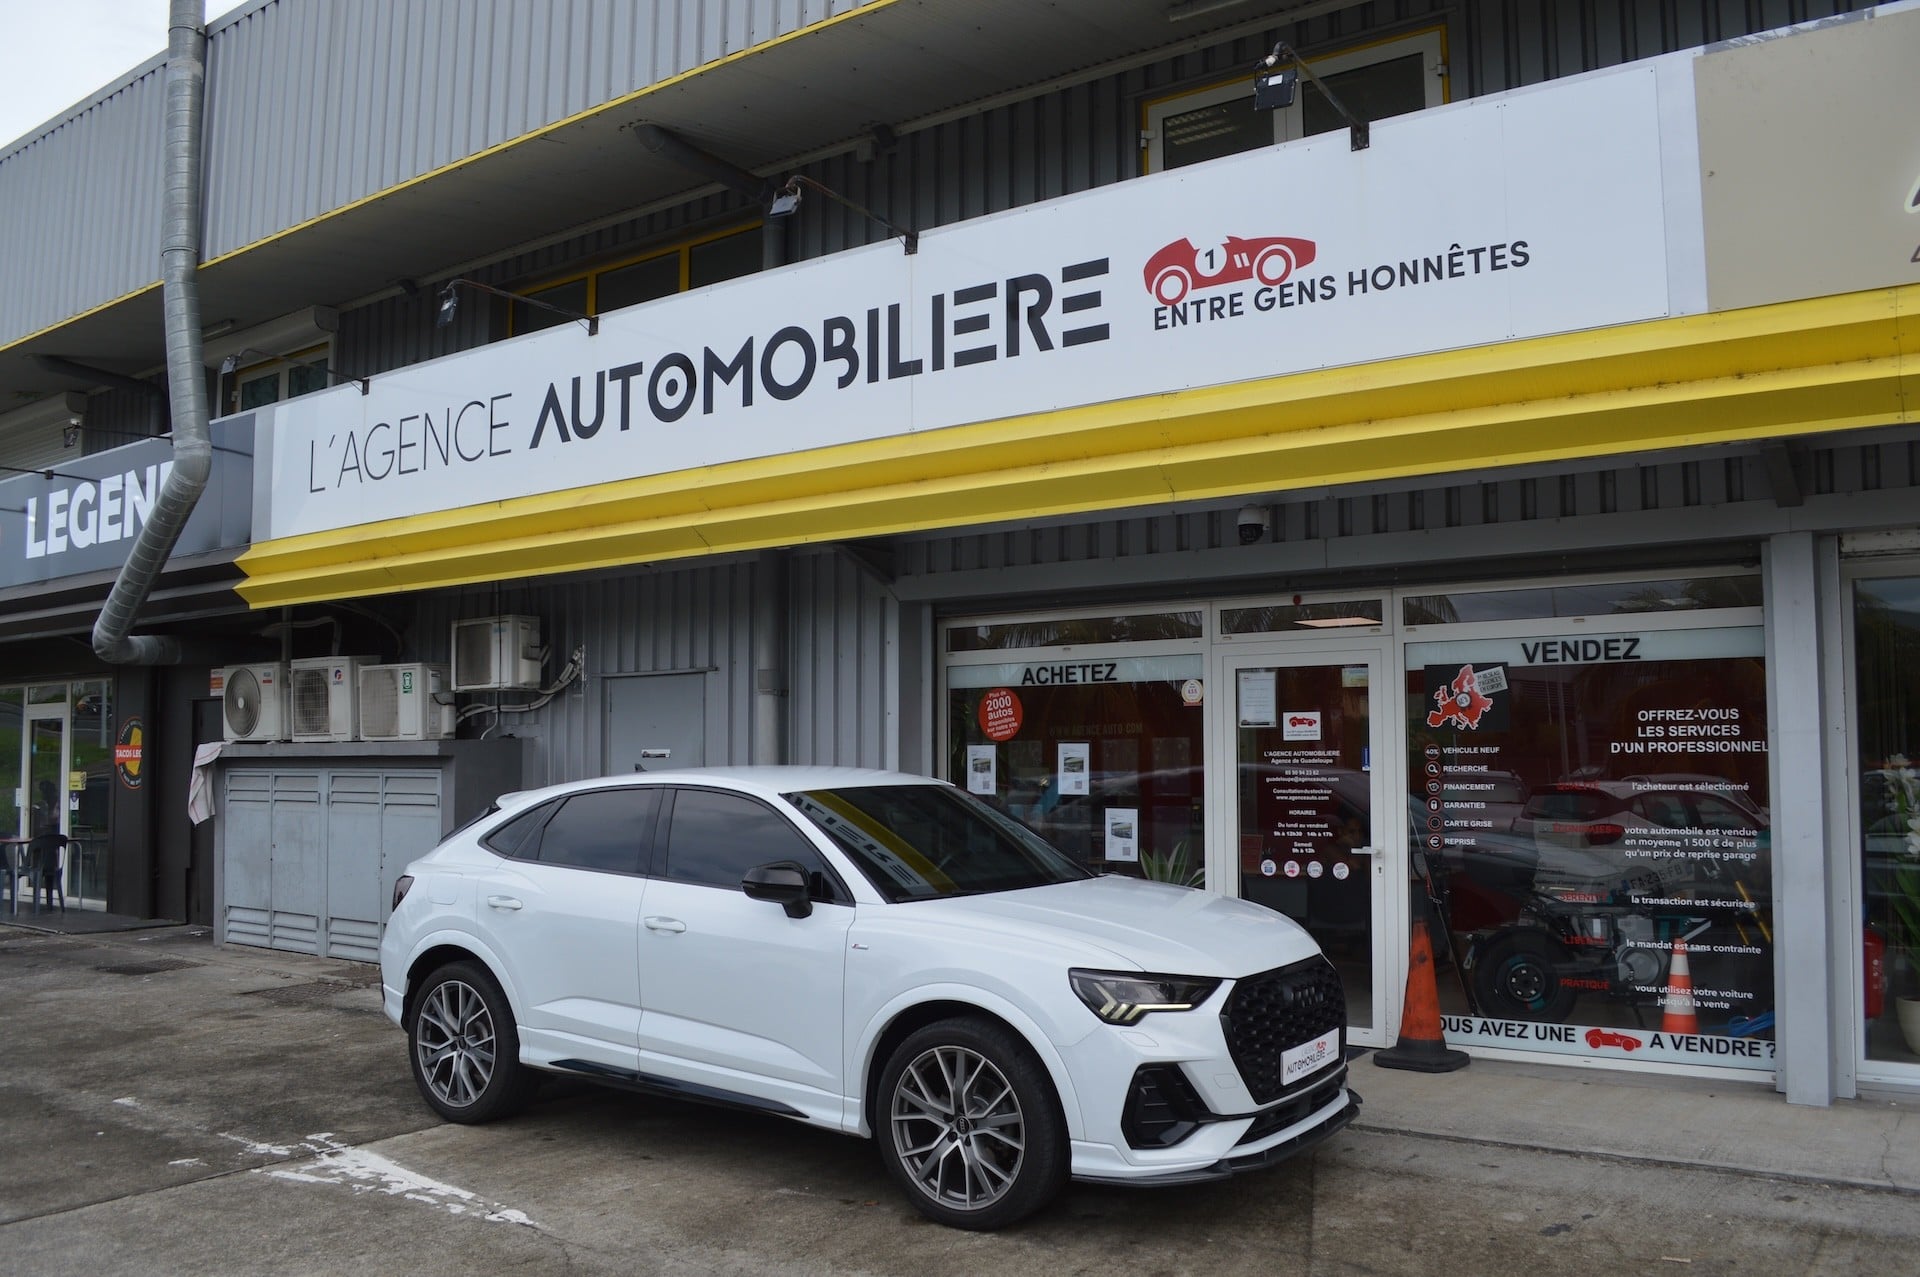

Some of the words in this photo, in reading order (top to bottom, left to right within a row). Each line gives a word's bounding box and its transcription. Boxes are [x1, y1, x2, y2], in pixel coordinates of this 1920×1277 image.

[1204, 249, 1215, 270] 1
[1154, 292, 1244, 331] ENTRE
[1254, 275, 1337, 312] GENS
[1348, 240, 1530, 297] HONNÊTES
[310, 393, 512, 493] L'AGENCE
[529, 257, 1110, 449] AUTOMOBILIERE
[1521, 637, 1641, 664] VENDEZ
[1021, 663, 1117, 685] ACHETEZ
[986, 695, 1012, 711] 2000
[988, 708, 1013, 720] autos
[1638, 708, 1740, 721] OFFREZ-VOUS
[1638, 726, 1665, 737] LES
[1668, 725, 1741, 737] SERVICES
[115, 749, 132, 758] TACOS
[1442, 746, 1479, 754] VEHICULE
[1480, 746, 1500, 754] NEUF
[1611, 742, 1644, 753] D'UN
[1648, 741, 1768, 753] PROFESSIONNEL
[1632, 782, 1677, 791] l'acheteur
[1695, 782, 1749, 791] sélectionné
[1650, 827, 1703, 836] automobile
[1722, 827, 1758, 836] vendue
[1639, 839, 1681, 848] moyenne
[1692, 838, 1711, 846] 500
[1713, 838, 1720, 847] €
[1722, 839, 1734, 847] de
[1737, 839, 1757, 849] plus
[1625, 849, 1651, 858] qu'un
[1653, 849, 1671, 858] prix
[1673, 849, 1686, 858] de
[1688, 850, 1720, 860] reprise
[1723, 852, 1757, 861] garage
[1631, 895, 1639, 904] la
[1641, 897, 1693, 906] transaction
[1711, 899, 1755, 909] sécurisée
[1626, 939, 1635, 947] le
[1637, 940, 1672, 950] mandat
[1690, 944, 1711, 952] sans
[1713, 944, 1761, 954] contrainte
[1658, 985, 1691, 995] utilisez
[1693, 988, 1717, 997] votre
[1720, 989, 1753, 999] voiture
[1692, 998, 1701, 1007] la
[1703, 1000, 1730, 1009] vente
[1479, 1021, 1529, 1040] AVEZ
[1535, 1026, 1576, 1043] UNE
[1650, 1033, 1664, 1049] A
[1671, 1035, 1761, 1057] VENDRE
[1766, 1042, 1776, 1058] ?
